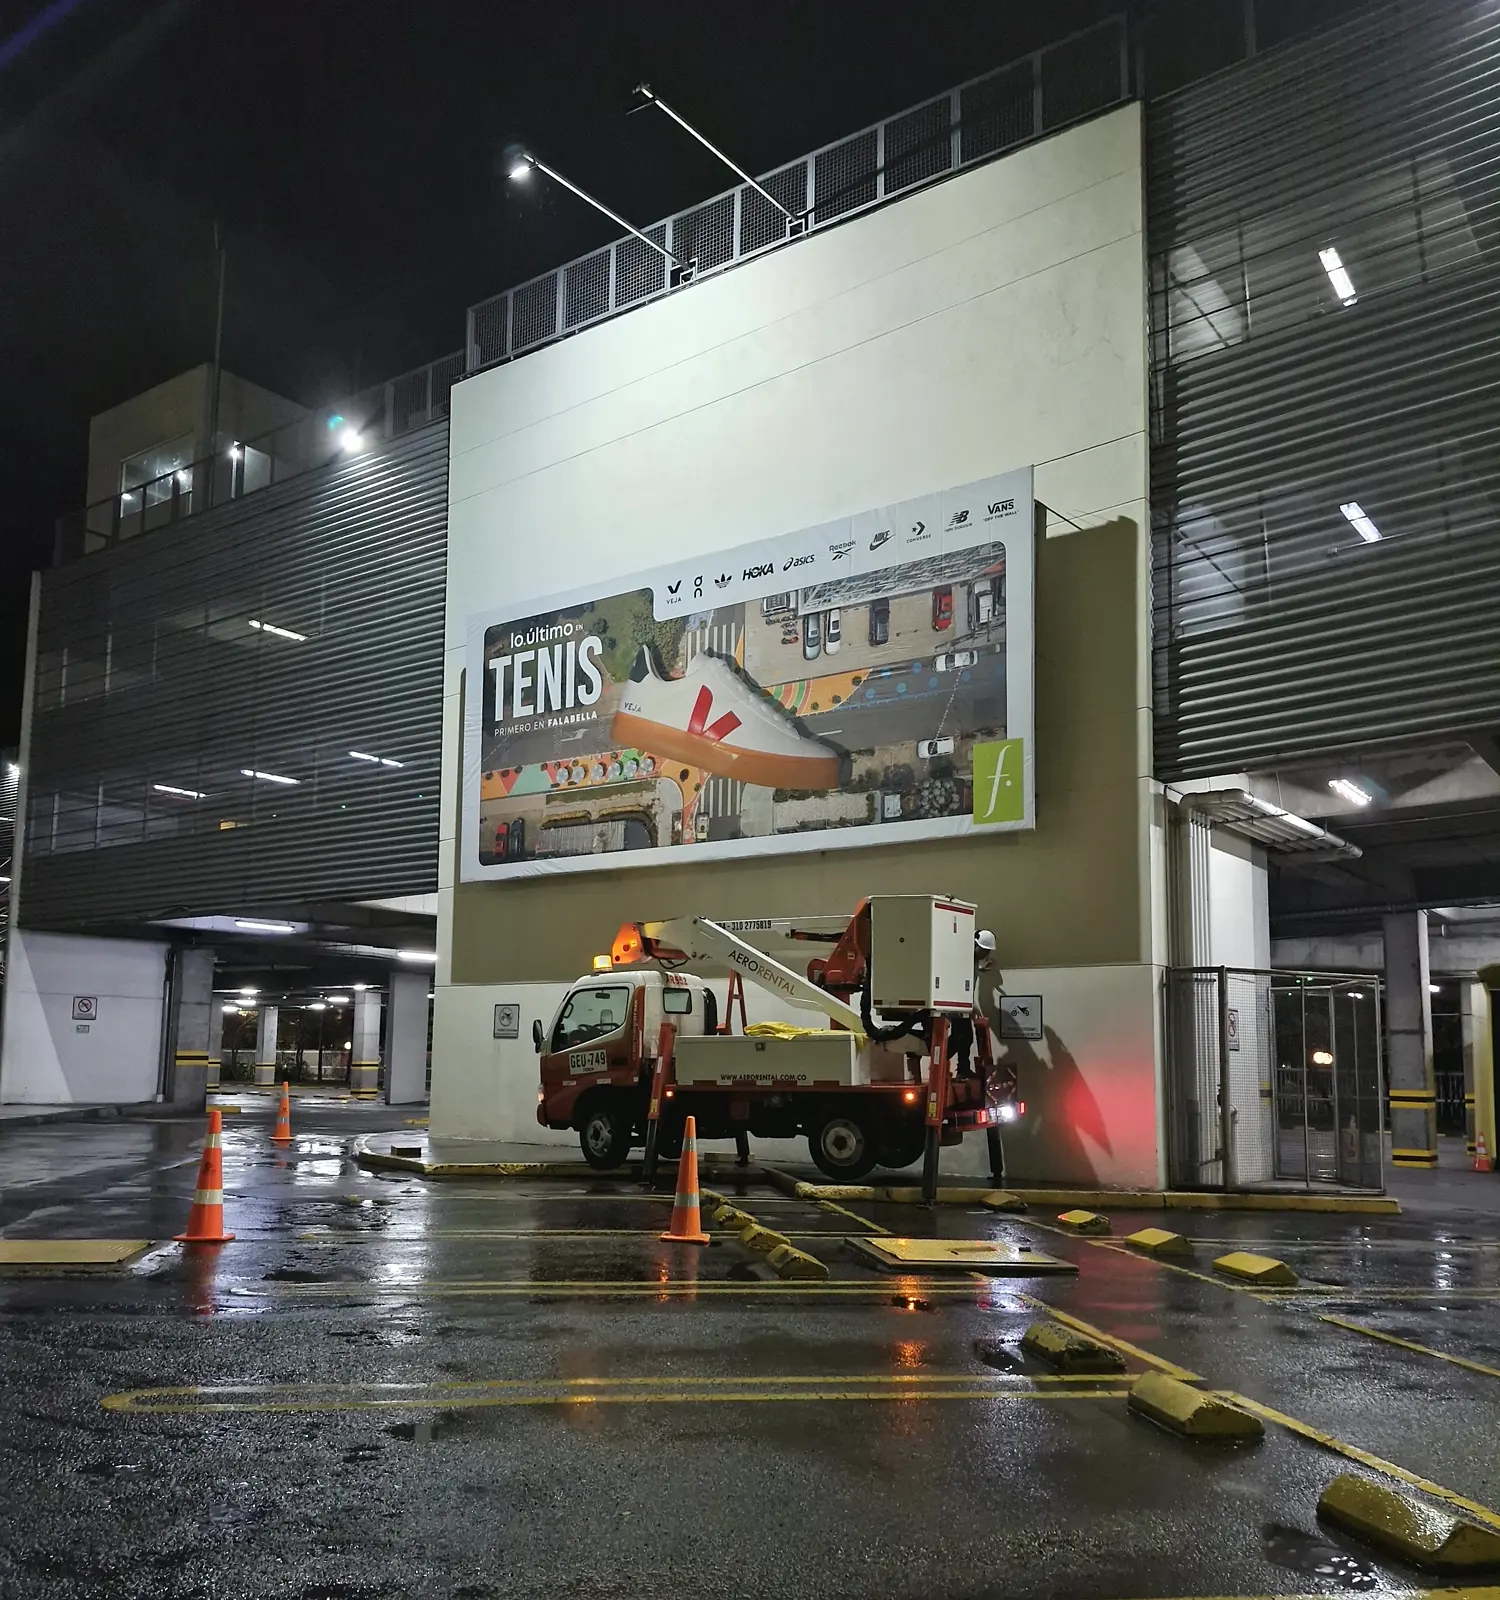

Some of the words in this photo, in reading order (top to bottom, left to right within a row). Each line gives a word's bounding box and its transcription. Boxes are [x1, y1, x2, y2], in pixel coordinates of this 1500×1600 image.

[987, 498, 1014, 515] VANS
[828, 540, 857, 552] Reebok
[906, 533, 932, 544] CONVERSE
[742, 563, 774, 581] HOKA
[666, 597, 682, 605] VEJA
[510, 622, 574, 649] lo.último
[575, 623, 584, 632] EN
[489, 635, 603, 722] TENIS
[624, 701, 642, 713] VEJA
[494, 722, 531, 737] PRIMERO
[533, 720, 545, 730] EN
[547, 711, 598, 727] FALABELLA
[732, 921, 743, 931] 310
[744, 920, 772, 930] 2775819
[728, 949, 796, 996] AERORENTAL
